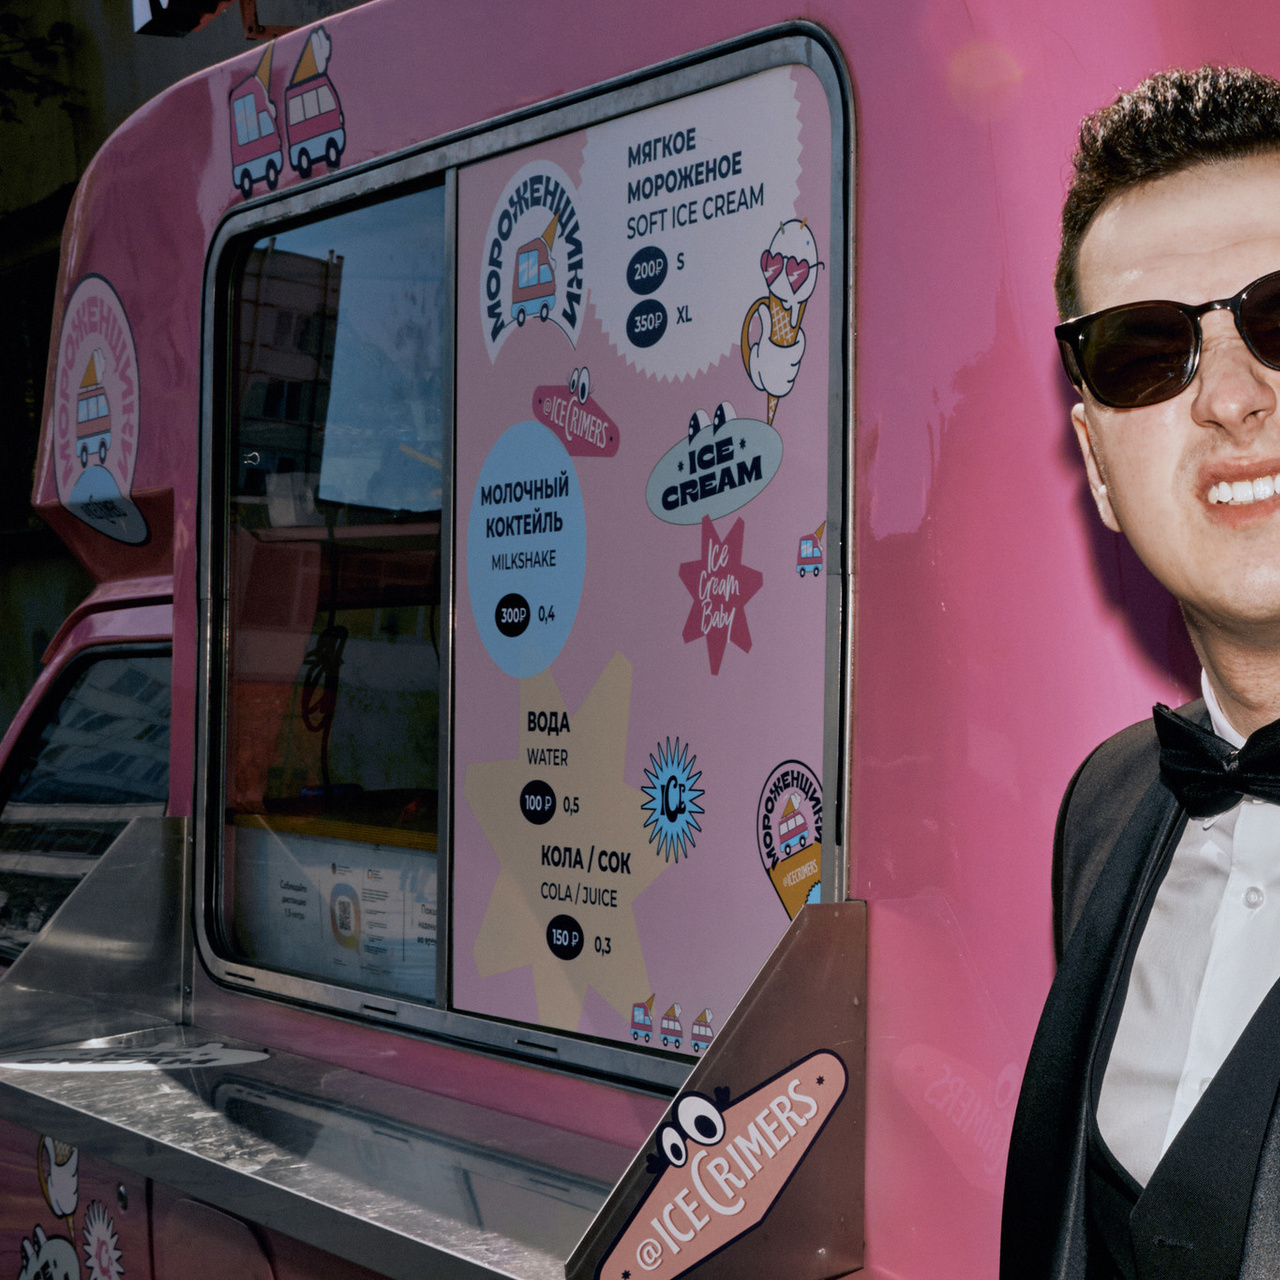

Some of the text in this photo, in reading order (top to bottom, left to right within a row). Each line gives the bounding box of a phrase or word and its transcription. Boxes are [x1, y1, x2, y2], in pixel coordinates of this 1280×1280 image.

[627, 127, 697, 169] МЯГКОЕ
[627, 150, 743, 205] МОРОЖЕНОЕ
[626, 182, 765, 240] SOFT ICE CREAM
[486, 174, 584, 344] МОРОЖЕНЩИКИ
[676, 251, 686, 272] S
[676, 304, 693, 326] XL
[57, 295, 135, 490] МОРОЖЕНЩИКИ
[688, 436, 735, 475] ICE
[480, 470, 569, 507] МОЛОЧНЫЙ
[661, 455, 763, 512] CREAM
[485, 507, 564, 539] КОКТЕЙЛЬ
[491, 549, 557, 572] MILKSHAKE
[706, 538, 730, 577] Ice
[699, 570, 740, 602] Cream
[537, 604, 556, 626] 0,4
[701, 599, 736, 643] Baby
[527, 710, 571, 736] ВОДА
[527, 747, 569, 767] WATER
[562, 795, 580, 818] 0,5
[541, 844, 585, 871] КОЛА
[597, 849, 632, 875] СОК
[540, 881, 574, 902] COLA
[582, 885, 618, 909] JUICE
[594, 935, 612, 958] 0,3
[635, 1078, 819, 1271] @ICECRIMERS
